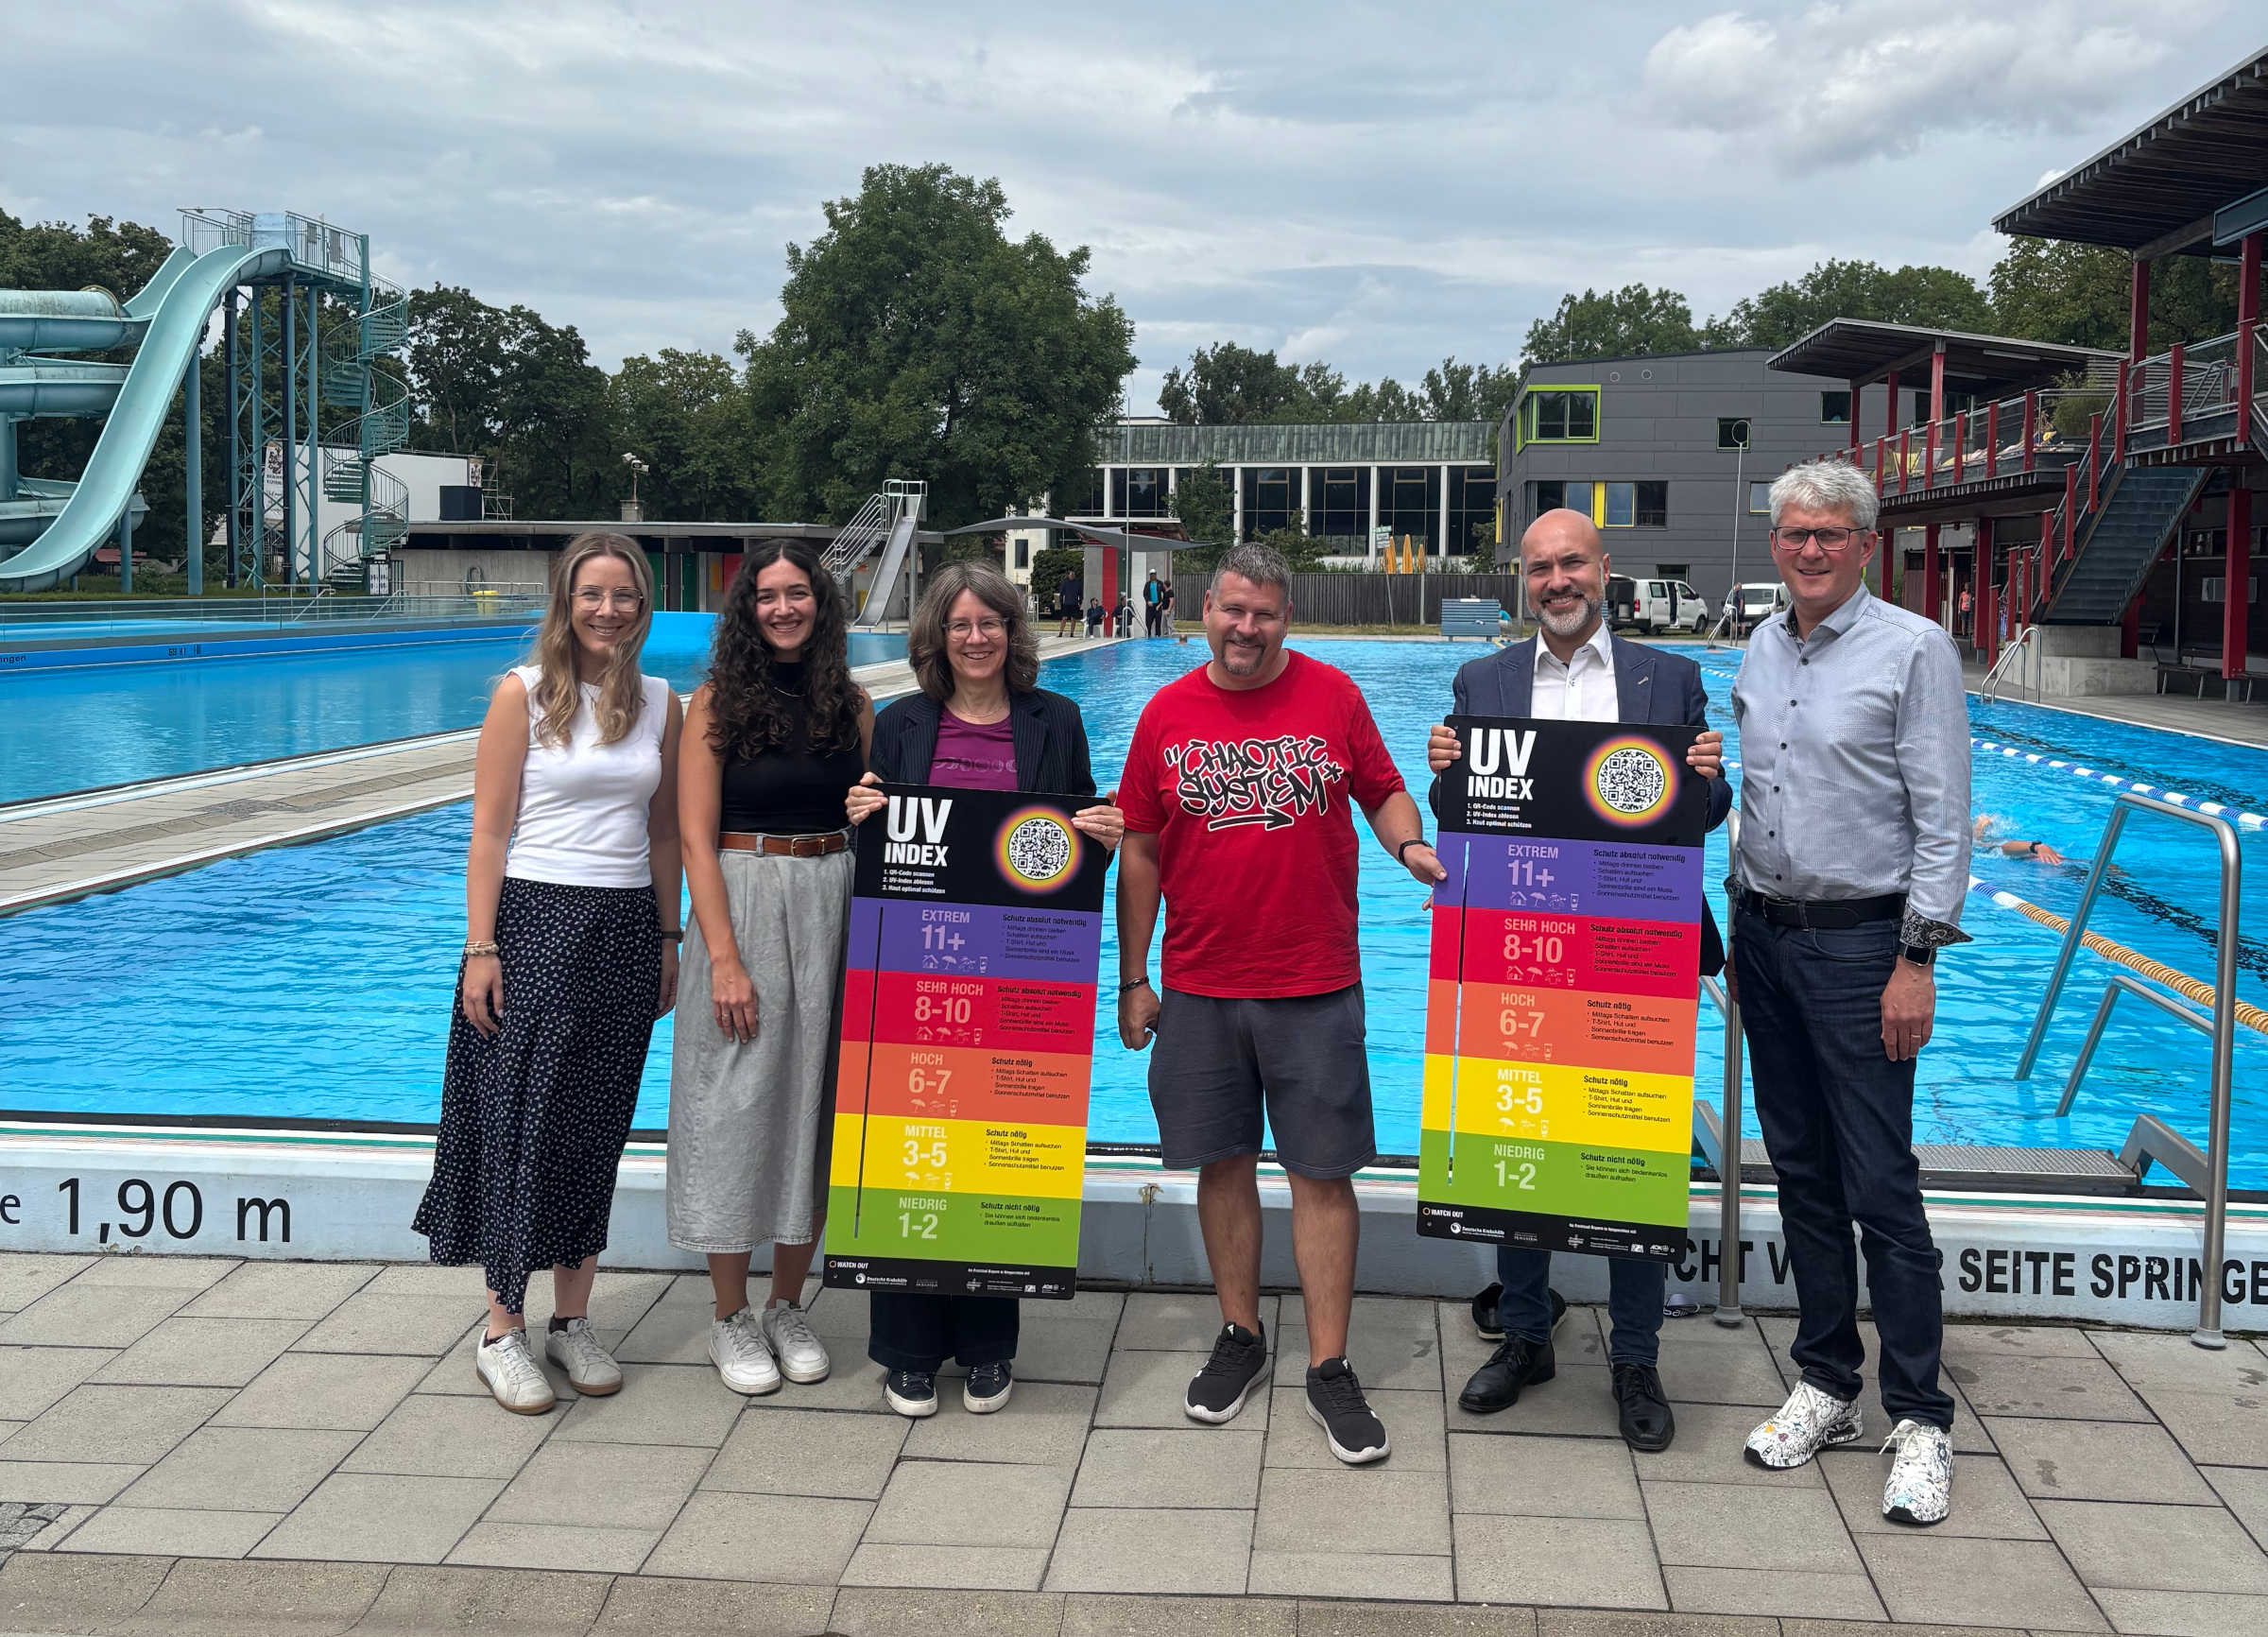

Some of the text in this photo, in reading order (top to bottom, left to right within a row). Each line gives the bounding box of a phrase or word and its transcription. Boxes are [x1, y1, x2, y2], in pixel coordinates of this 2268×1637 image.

[1469, 728, 1537, 777] UV
[1468, 775, 1534, 801] INDEX
[887, 796, 953, 844] UV
[885, 842, 949, 867] INDEX
[1508, 844, 1558, 858] EXTREM
[1593, 849, 1685, 863] Schutz absolut notwendig
[1508, 859, 1555, 887] 11+
[922, 909, 970, 922] EXTREM
[1504, 918, 1575, 934] SEHR HOCH
[922, 924, 965, 951] 11+
[1503, 934, 1562, 963] 8-10
[917, 980, 983, 996] SEHR HOCH
[1502, 992, 1535, 1007] HOCH
[1587, 999, 1631, 1011] Schutz nötig
[915, 995, 971, 1024] 8-10
[1500, 1009, 1544, 1037] 6-7
[910, 1052, 943, 1065] HOCH
[991, 1057, 1032, 1067] Schutz nötig
[908, 1068, 952, 1094] 6-7
[1497, 1068, 1542, 1084] MITTEL
[1583, 1075, 1627, 1088] Schutz nötig
[1496, 1084, 1542, 1114] 3-5
[904, 1125, 947, 1138] MITTEL
[986, 1129, 1026, 1139] Schutz nötig
[902, 1140, 947, 1167] 3-5
[1493, 1144, 1545, 1160] NIEDRIG
[1580, 1152, 1644, 1167] Schutz nicht nötig
[1493, 1161, 1536, 1190] 1-2
[59, 1178, 202, 1243] 1,90
[236, 1198, 290, 1243] m
[899, 1197, 947, 1211] NIEDRIG
[980, 1201, 1003, 1210] Schutz
[1023, 1204, 1040, 1213] nötig
[899, 1212, 938, 1239] 1-2
[1959, 1249, 2075, 1296] SEITE
